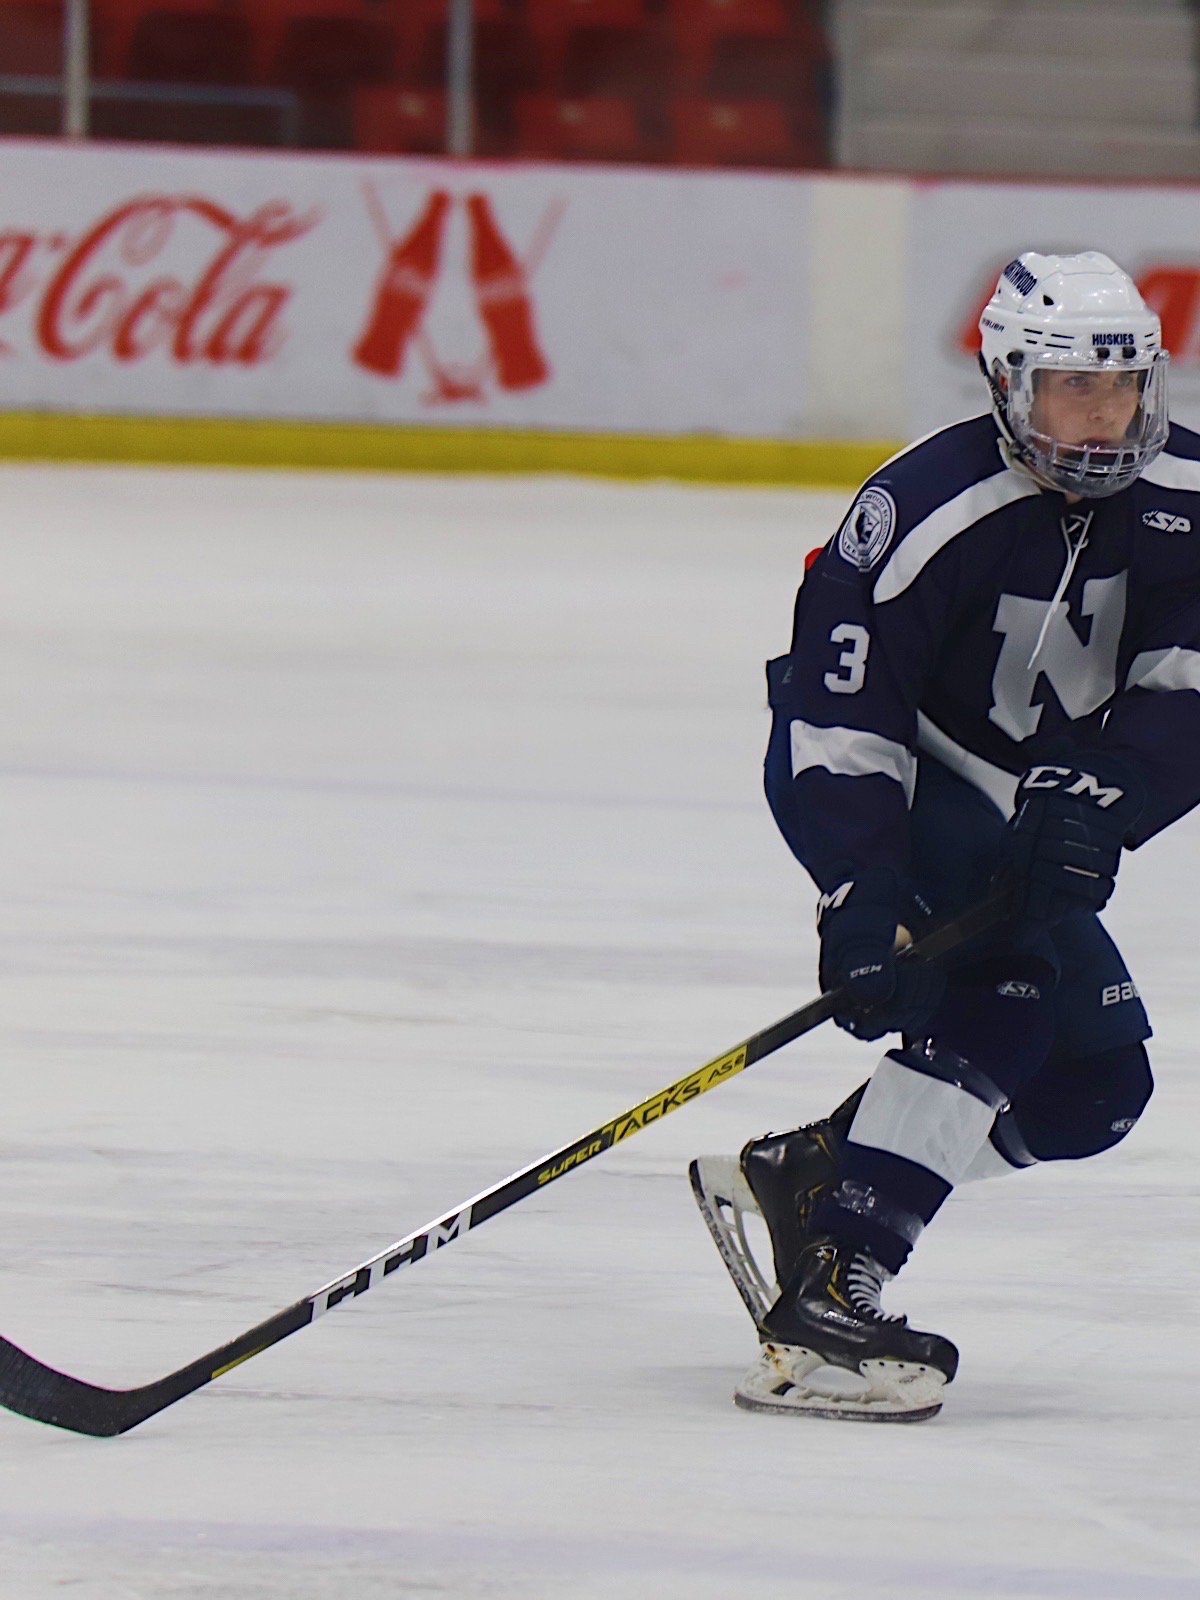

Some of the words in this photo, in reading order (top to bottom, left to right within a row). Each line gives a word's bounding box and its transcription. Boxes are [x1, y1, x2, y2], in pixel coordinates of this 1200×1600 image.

[1092, 333, 1135, 346] HUSKIES
[824, 623, 870, 694] 3
[988, 569, 1128, 742] N
[850, 964, 882, 979] CCM
[538, 1140, 602, 1185] SUPER
[602, 1077, 702, 1148] TACKS
[308, 1205, 473, 1322] CCM
